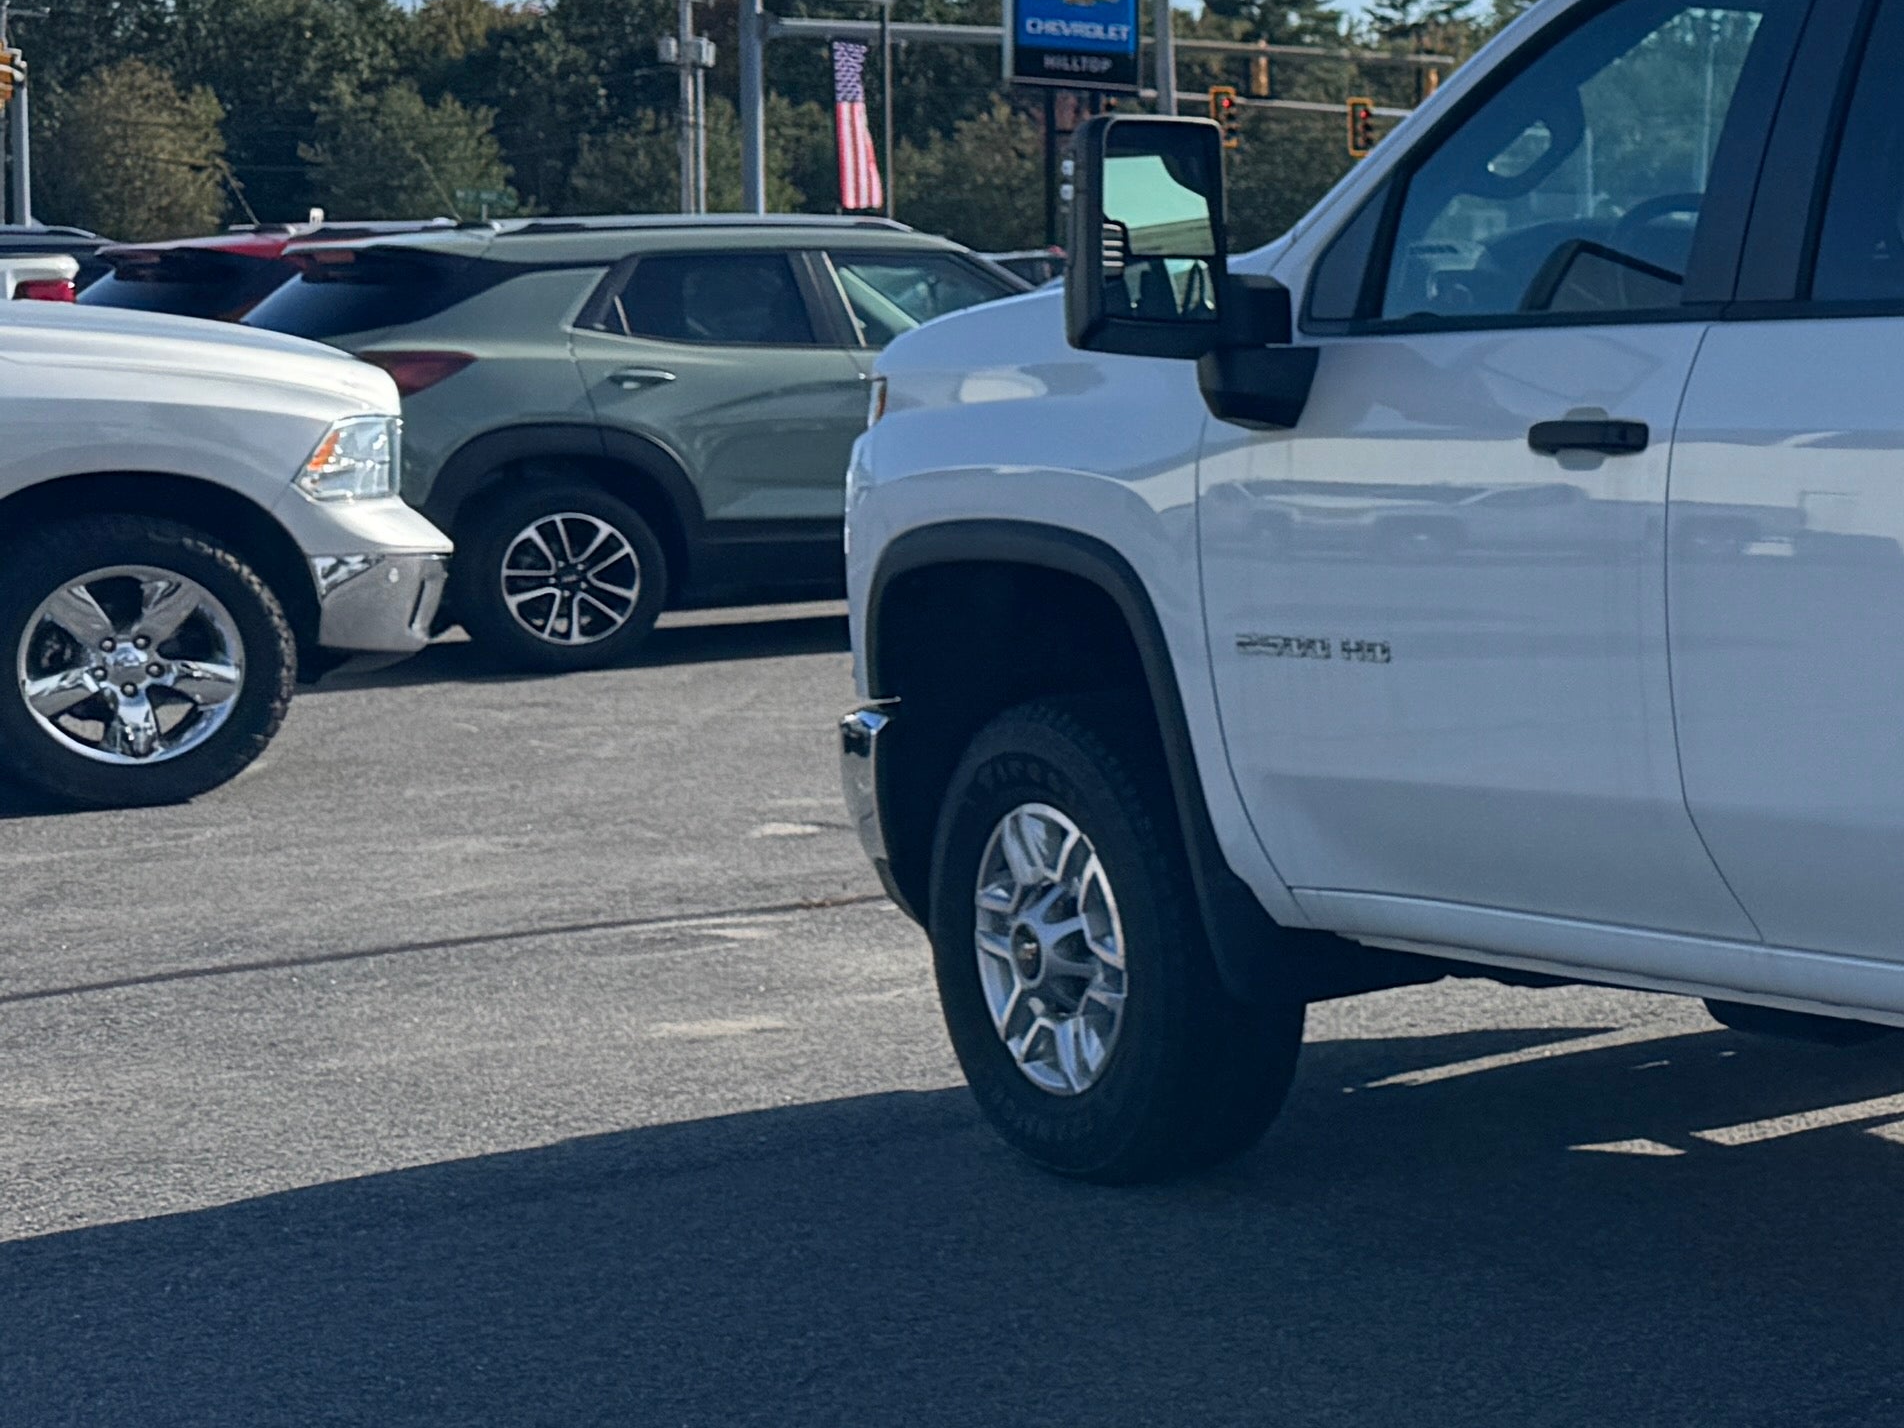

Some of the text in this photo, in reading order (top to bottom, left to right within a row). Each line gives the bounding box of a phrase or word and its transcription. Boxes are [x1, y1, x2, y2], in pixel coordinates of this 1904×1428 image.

[1025, 17, 1131, 42] CHEVROLET
[1043, 53, 1113, 73] HILLTOP
[1236, 633, 1391, 664] 2500 HD
